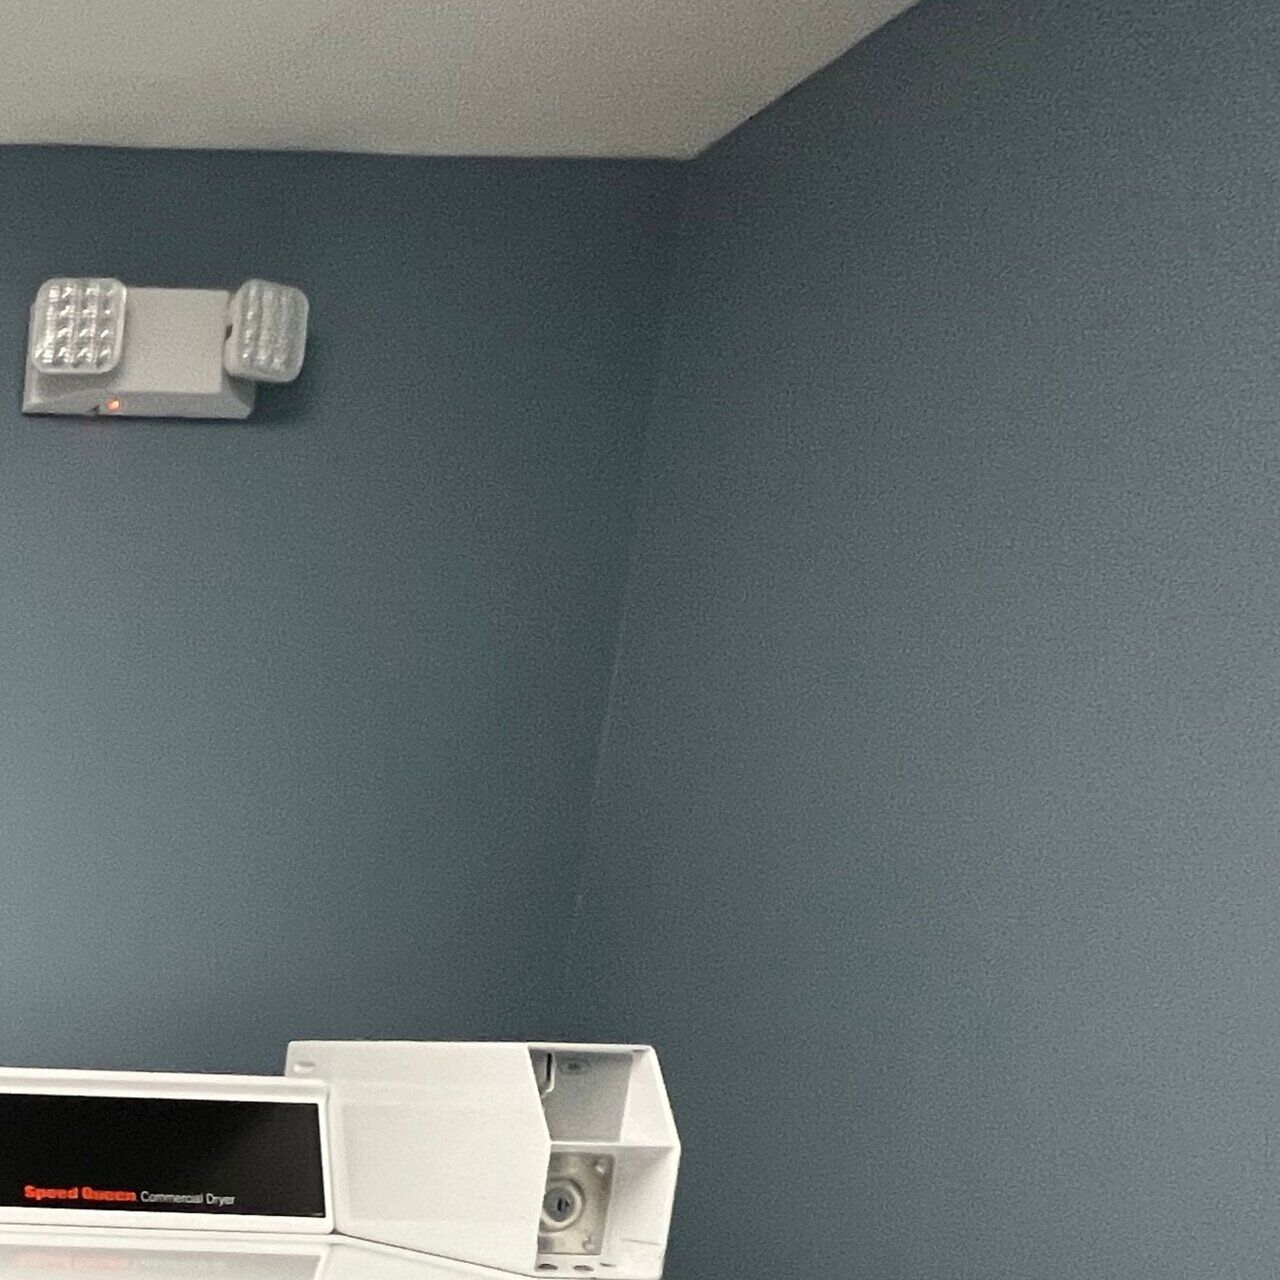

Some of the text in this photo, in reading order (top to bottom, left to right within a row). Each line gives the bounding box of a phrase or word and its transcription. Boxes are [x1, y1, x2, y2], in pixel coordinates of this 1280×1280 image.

[24, 1185, 235, 1206] Speed Queen Commercial Dryer
